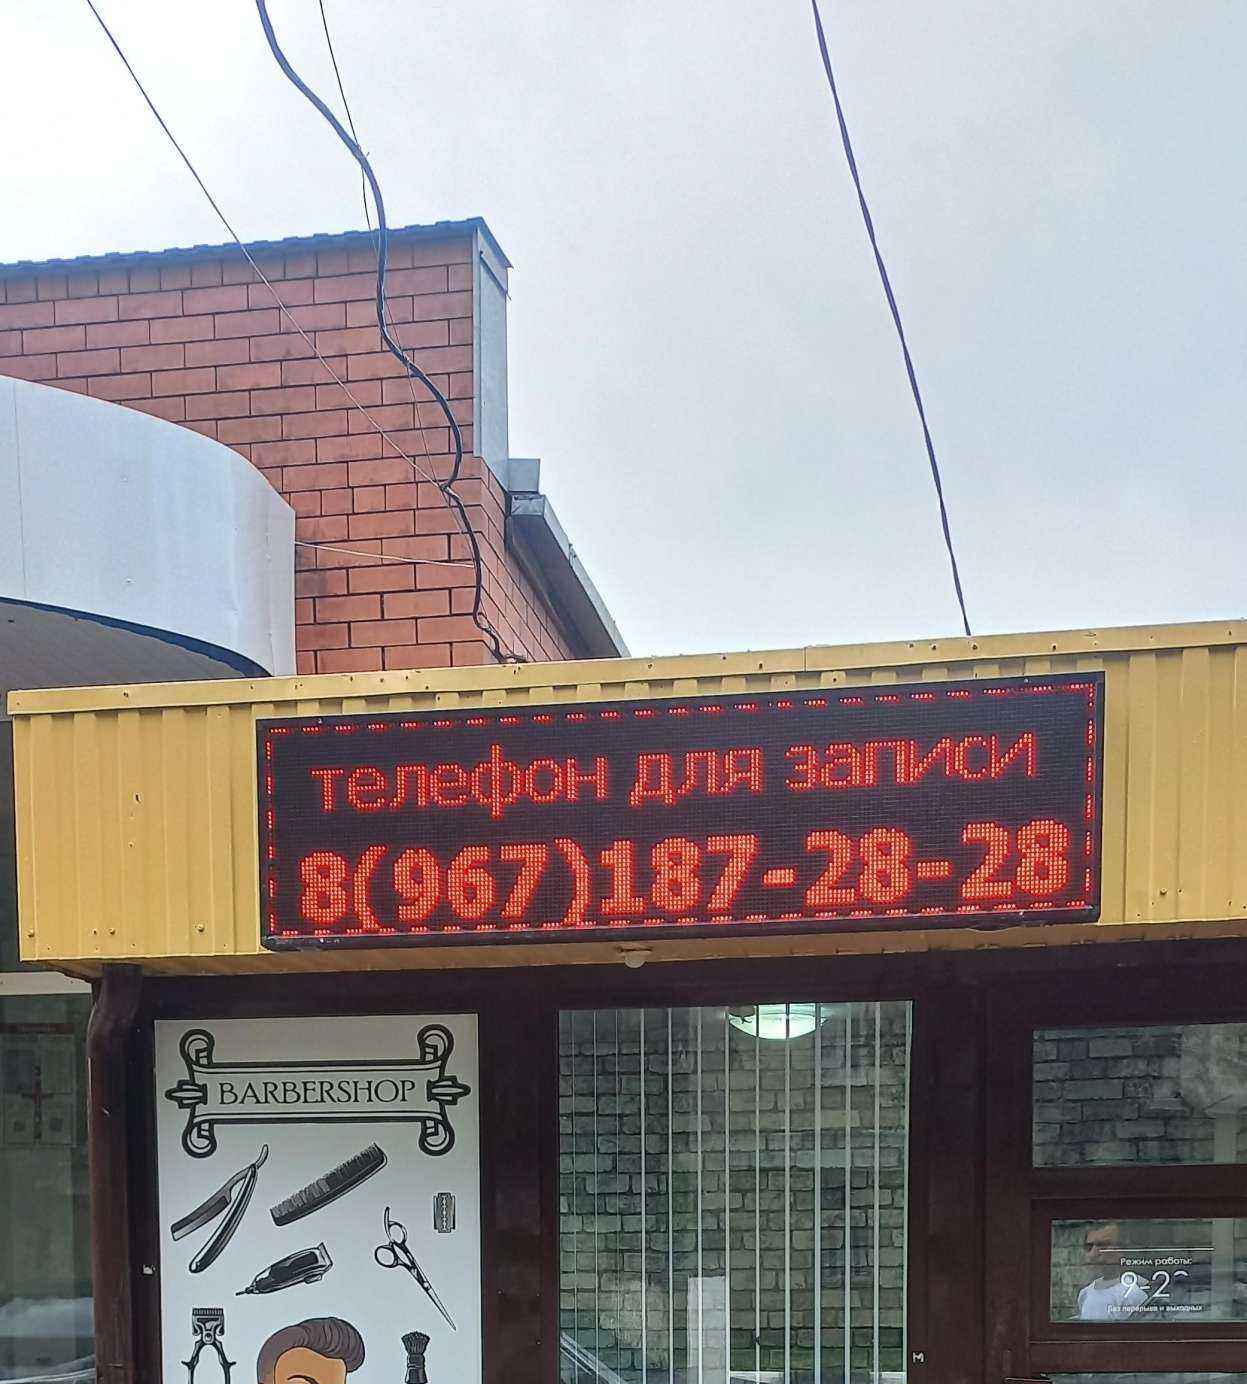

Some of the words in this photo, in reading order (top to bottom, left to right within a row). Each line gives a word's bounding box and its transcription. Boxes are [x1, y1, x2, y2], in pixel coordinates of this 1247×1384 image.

[311, 743, 609, 820] телефон
[628, 747, 762, 807] для
[784, 730, 1037, 791] записи
[299, 818, 1070, 930] 8(967)187-28-28
[218, 1078, 416, 1105] BARBERSHOP
[1120, 1256, 1153, 1266] Режим
[1155, 1255, 1193, 1268] работы:
[1120, 1269, 1189, 1299] 9-2
